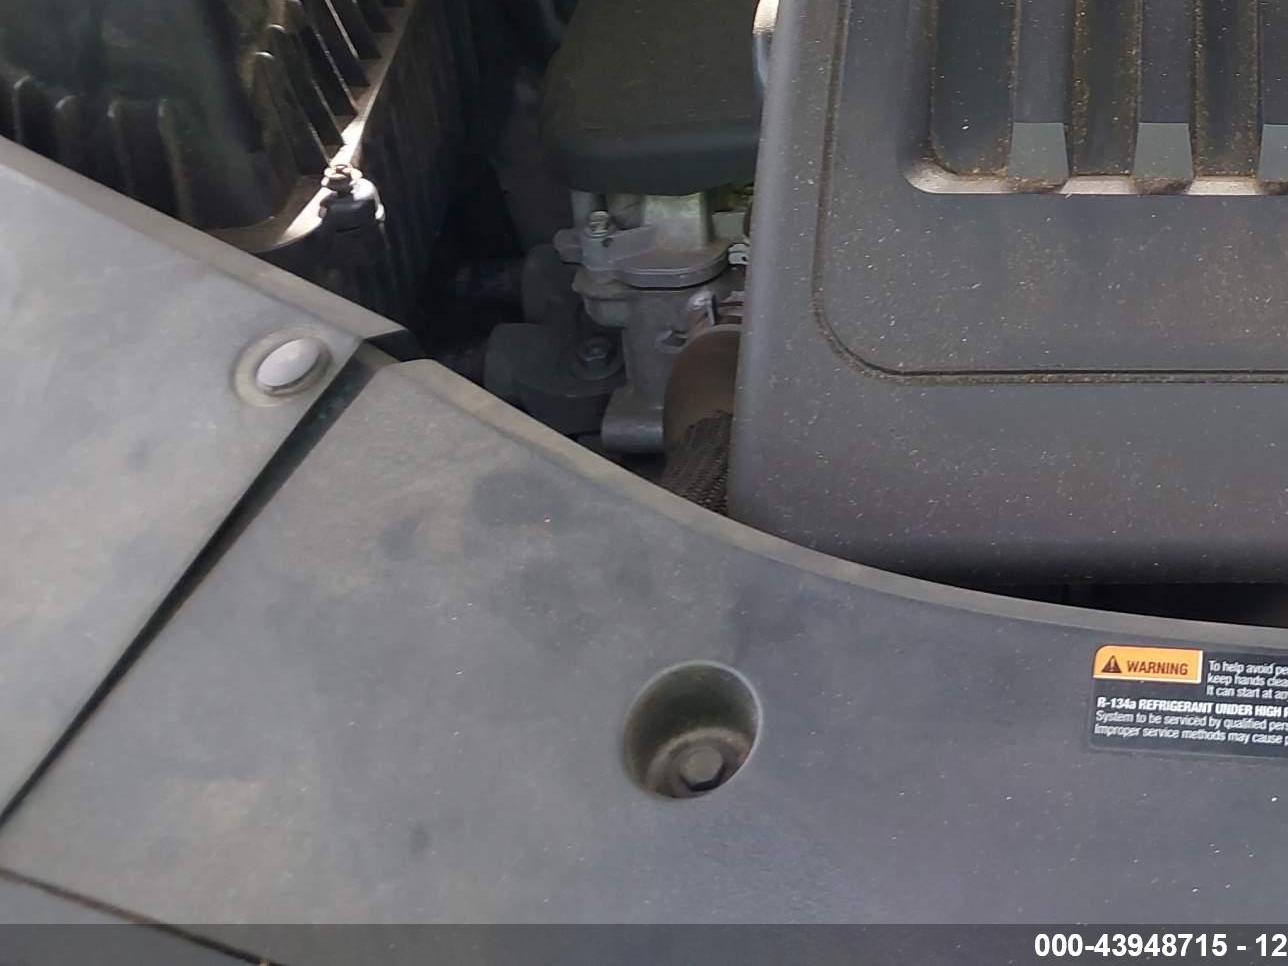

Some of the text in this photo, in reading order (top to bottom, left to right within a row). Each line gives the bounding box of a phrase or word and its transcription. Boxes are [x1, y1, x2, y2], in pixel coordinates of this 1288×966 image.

[1127, 660, 1188, 676] WARNING
[1209, 660, 1220, 671] To
[1222, 661, 1244, 675] help
[1246, 661, 1274, 675] avoid
[1207, 672, 1232, 686] keep
[1234, 674, 1265, 686] hands
[1206, 685, 1214, 696] It
[1216, 687, 1235, 697] can
[1236, 687, 1261, 698] start
[1262, 689, 1273, 699] at
[1097, 696, 1136, 710] R-134a
[1138, 699, 1213, 714] REFRIGERANT
[1215, 702, 1253, 716] UNDER
[1255, 704, 1281, 717] HIGH
[1096, 710, 1134, 724] System
[1136, 712, 1147, 724] to
[1148, 713, 1162, 724] be
[1163, 714, 1206, 727] serviced
[1208, 716, 1222, 729] by
[1223, 717, 1266, 731] qualified
[1094, 724, 1141, 738] Improper
[1142, 727, 1179, 739] service
[1181, 729, 1226, 741] methods
[1228, 733, 1250, 744] may
[1252, 734, 1282, 744] cause
